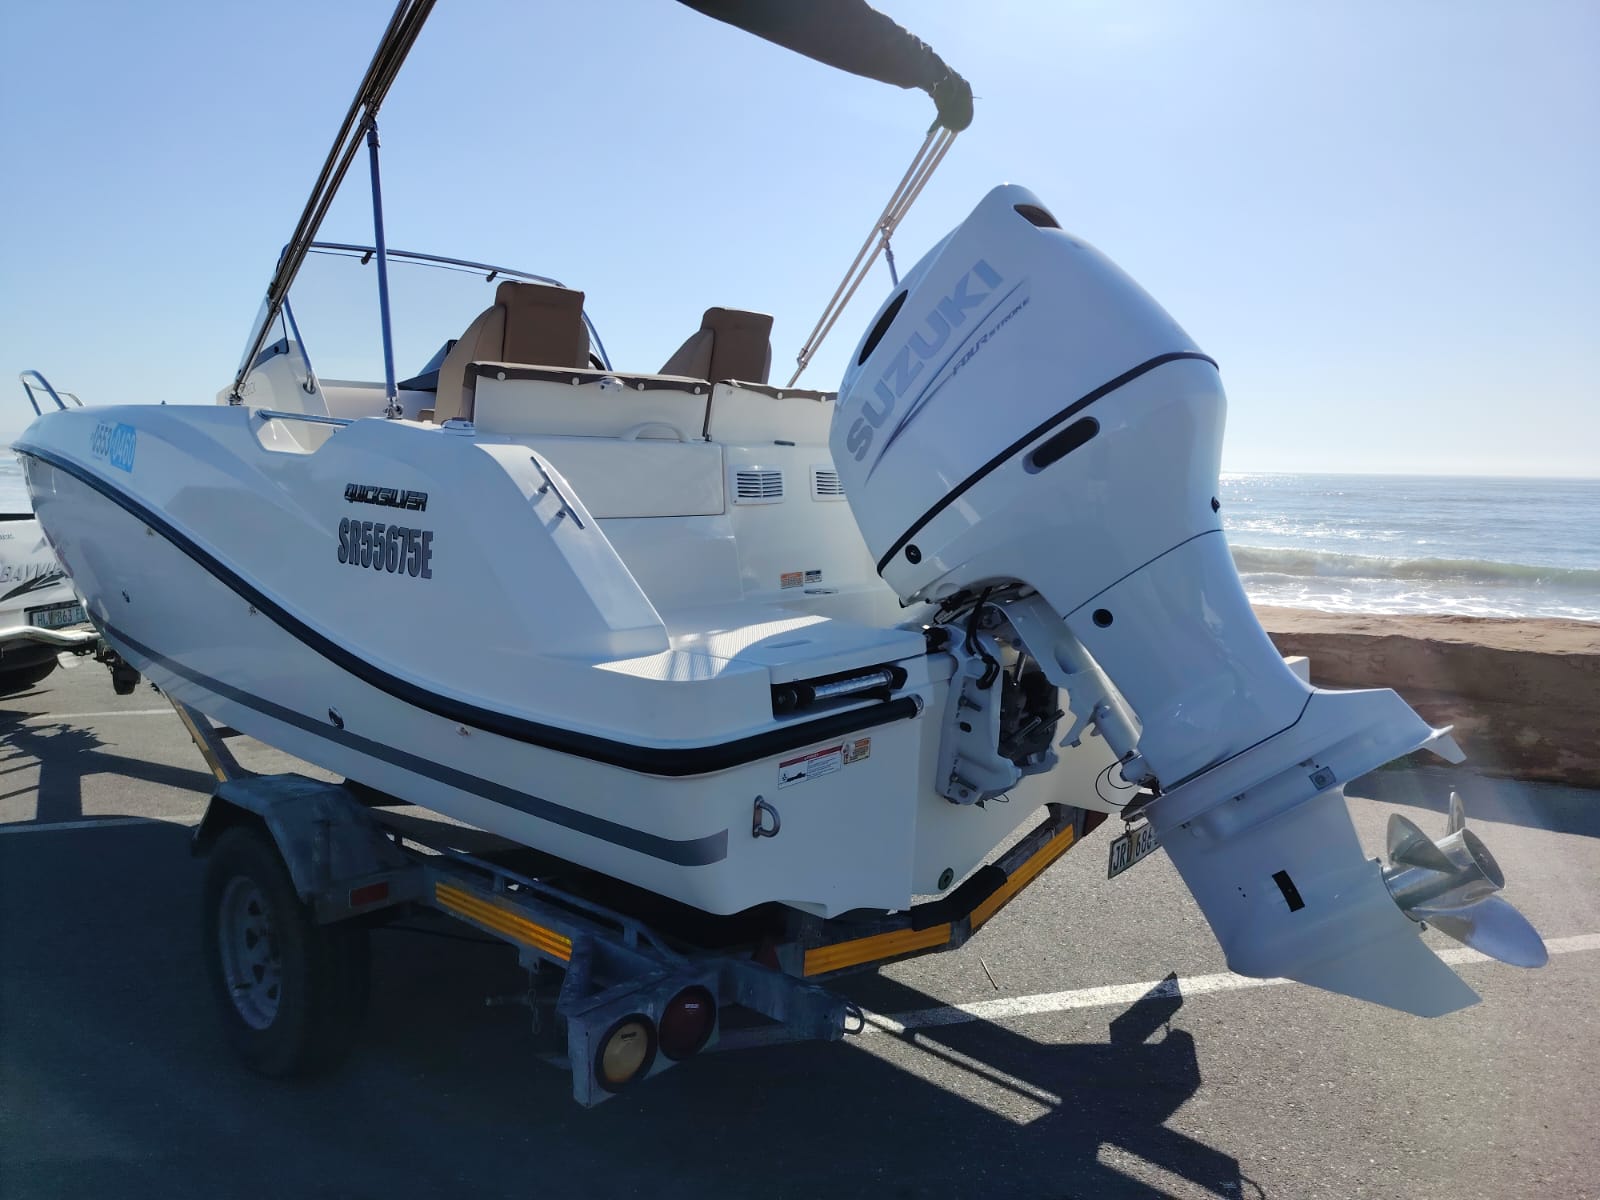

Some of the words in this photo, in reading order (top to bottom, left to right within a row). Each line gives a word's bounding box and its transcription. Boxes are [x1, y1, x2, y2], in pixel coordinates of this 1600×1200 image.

[846, 259, 1003, 462] SUZUKI
[344, 483, 428, 512] QUICKSILVER
[337, 517, 434, 580] SR55675E
